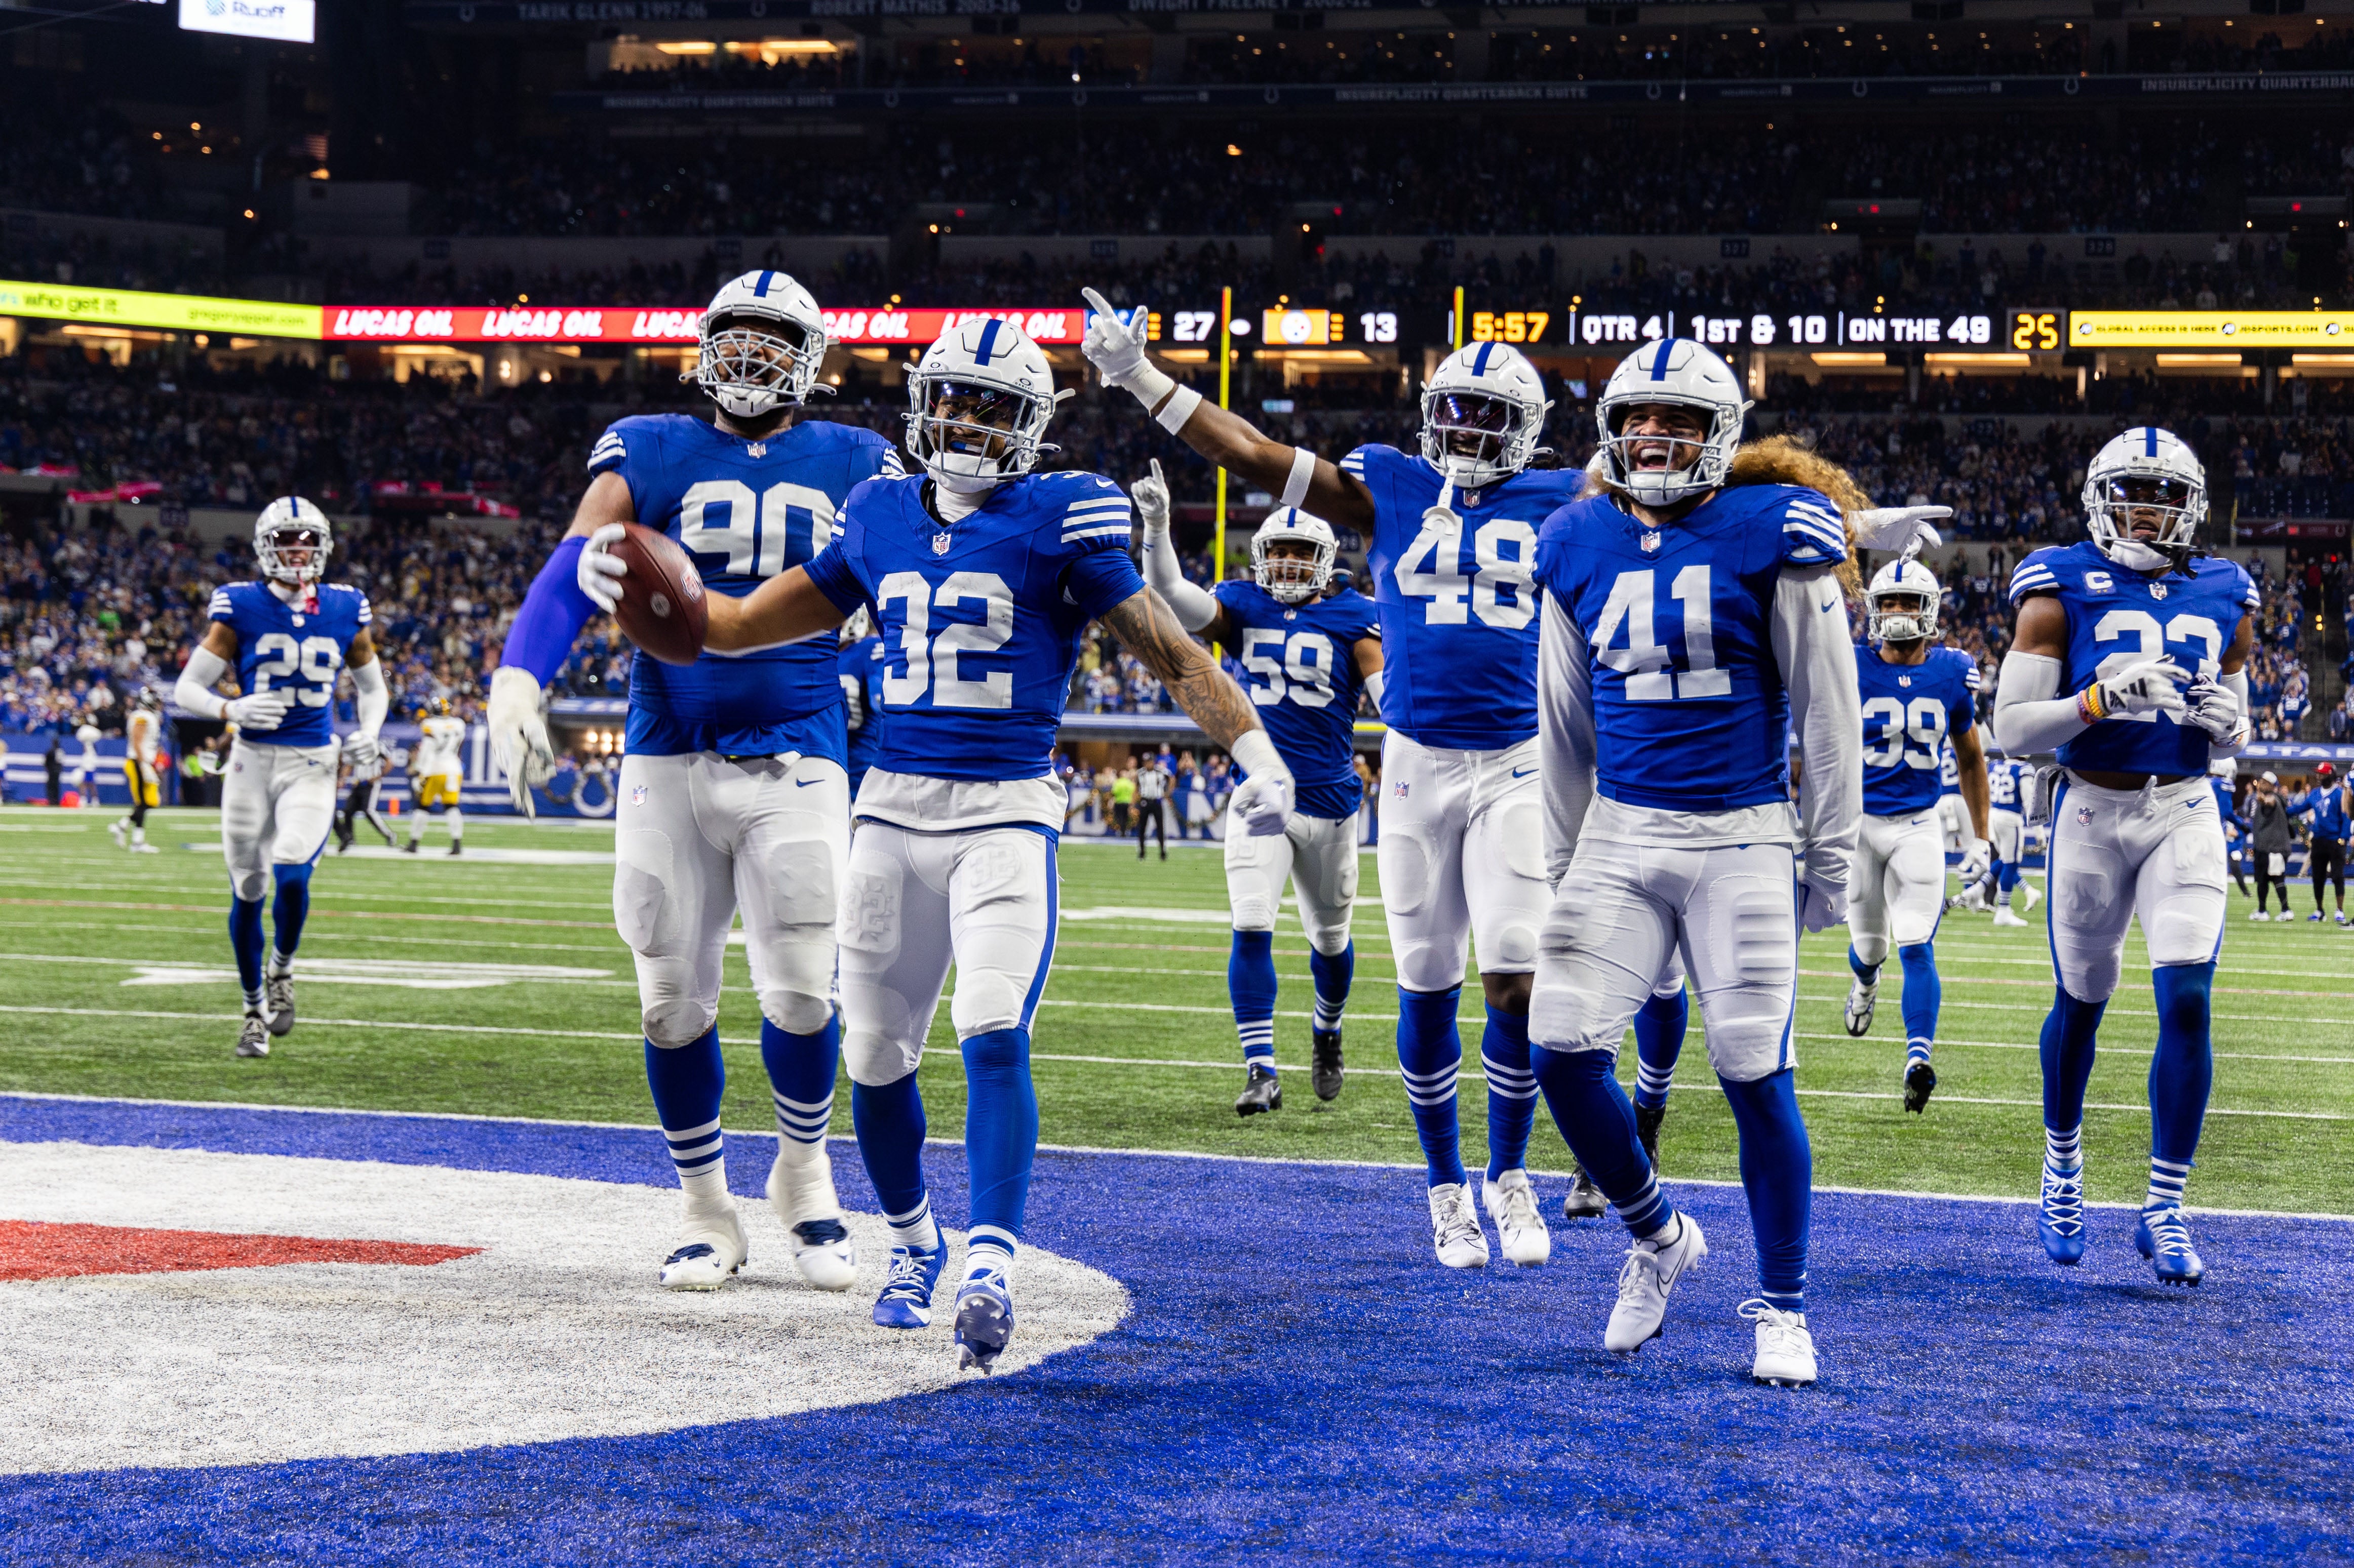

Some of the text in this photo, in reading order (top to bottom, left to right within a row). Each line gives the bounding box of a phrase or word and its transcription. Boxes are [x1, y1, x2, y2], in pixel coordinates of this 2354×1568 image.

[232, 1, 285, 18] Ruoff
[519, 3, 568, 20] TARIK
[574, 2, 636, 19] GLENN
[1724, 241, 1747, 255] 327
[24, 292, 63, 308] who
[67, 295, 100, 313] get
[333, 310, 454, 337] LUCAS OIL
[481, 310, 604, 338] LUCAS OIL
[869, 312, 910, 339] OIL
[1025, 312, 1067, 339] OIL
[1173, 312, 1215, 342] 27
[1361, 312, 1397, 342] 13
[1473, 312, 1549, 342] 5:57
[1582, 315, 1662, 344] QTR 4
[1691, 315, 1827, 344] 1ST & 10
[1849, 315, 1991, 344] ON THE 49
[2014, 313, 2058, 350] 25
[680, 480, 836, 576] 90
[934, 542, 947, 550] NFL
[1644, 541, 1657, 549] NFL
[1394, 515, 1537, 630] 48
[2085, 572, 2112, 590] C
[877, 571, 1013, 709] 32
[1591, 565, 1732, 701] 41
[254, 634, 342, 707] 29
[1242, 628, 1336, 707] 59
[1862, 697, 1946, 770] 39
